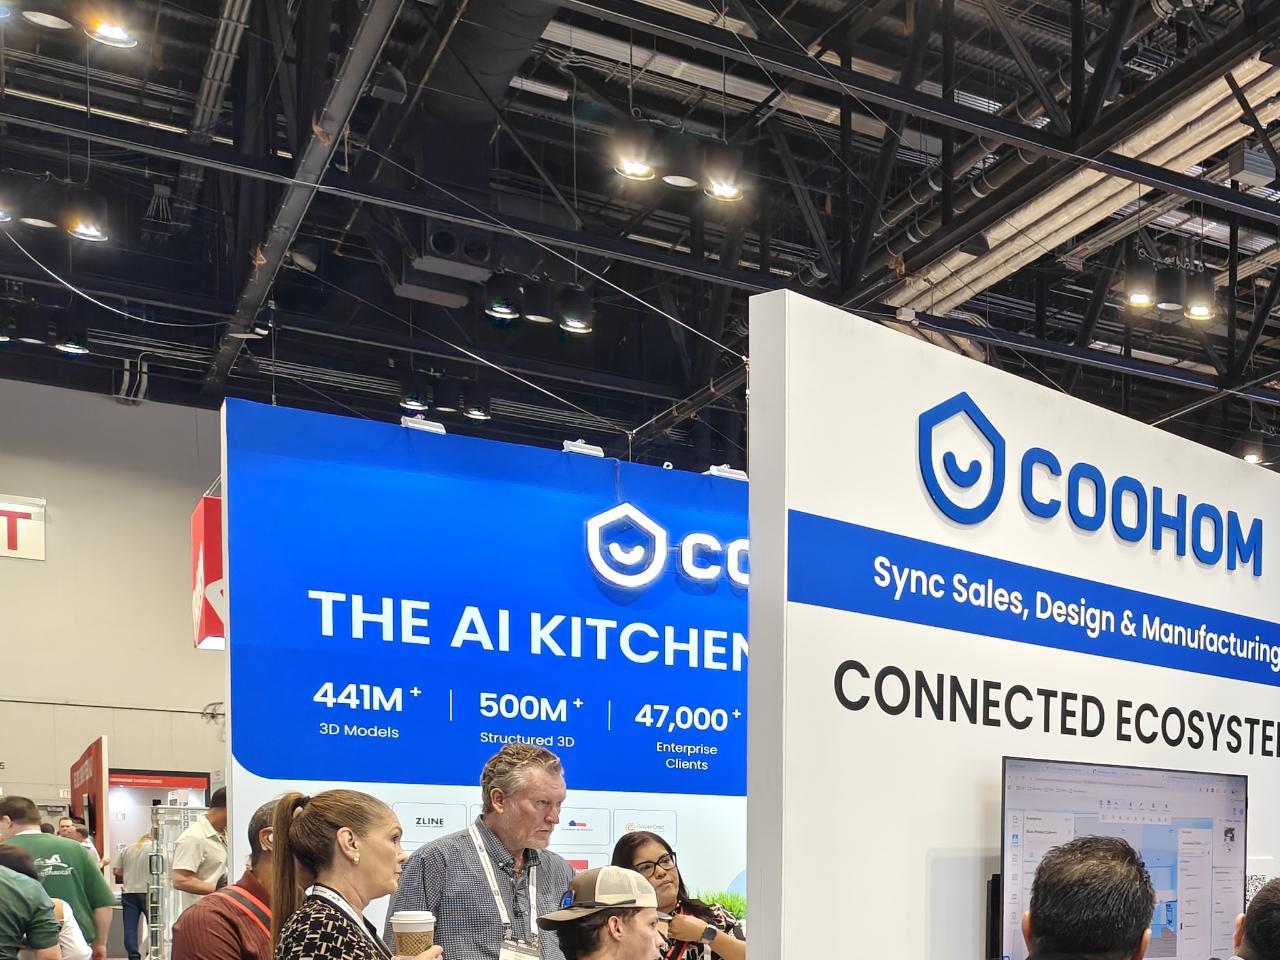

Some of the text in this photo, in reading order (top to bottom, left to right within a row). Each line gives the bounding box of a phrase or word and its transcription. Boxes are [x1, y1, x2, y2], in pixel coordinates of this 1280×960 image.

[1020, 447, 1263, 577] COOHOM
[873, 555, 945, 600] Sync
[952, 573, 1028, 622] Sales,
[1036, 589, 1115, 639] Design
[1120, 610, 1137, 636] &
[308, 589, 749, 672] THE AI KITCHEN
[834, 659, 1104, 738] CONNECTED
[319, 722, 400, 740] 3D Models
[480, 730, 575, 748] Structured 3D
[656, 741, 718, 758] Enterprise
[665, 758, 708, 771] Clients
[416, 817, 444, 825] ZLINE
